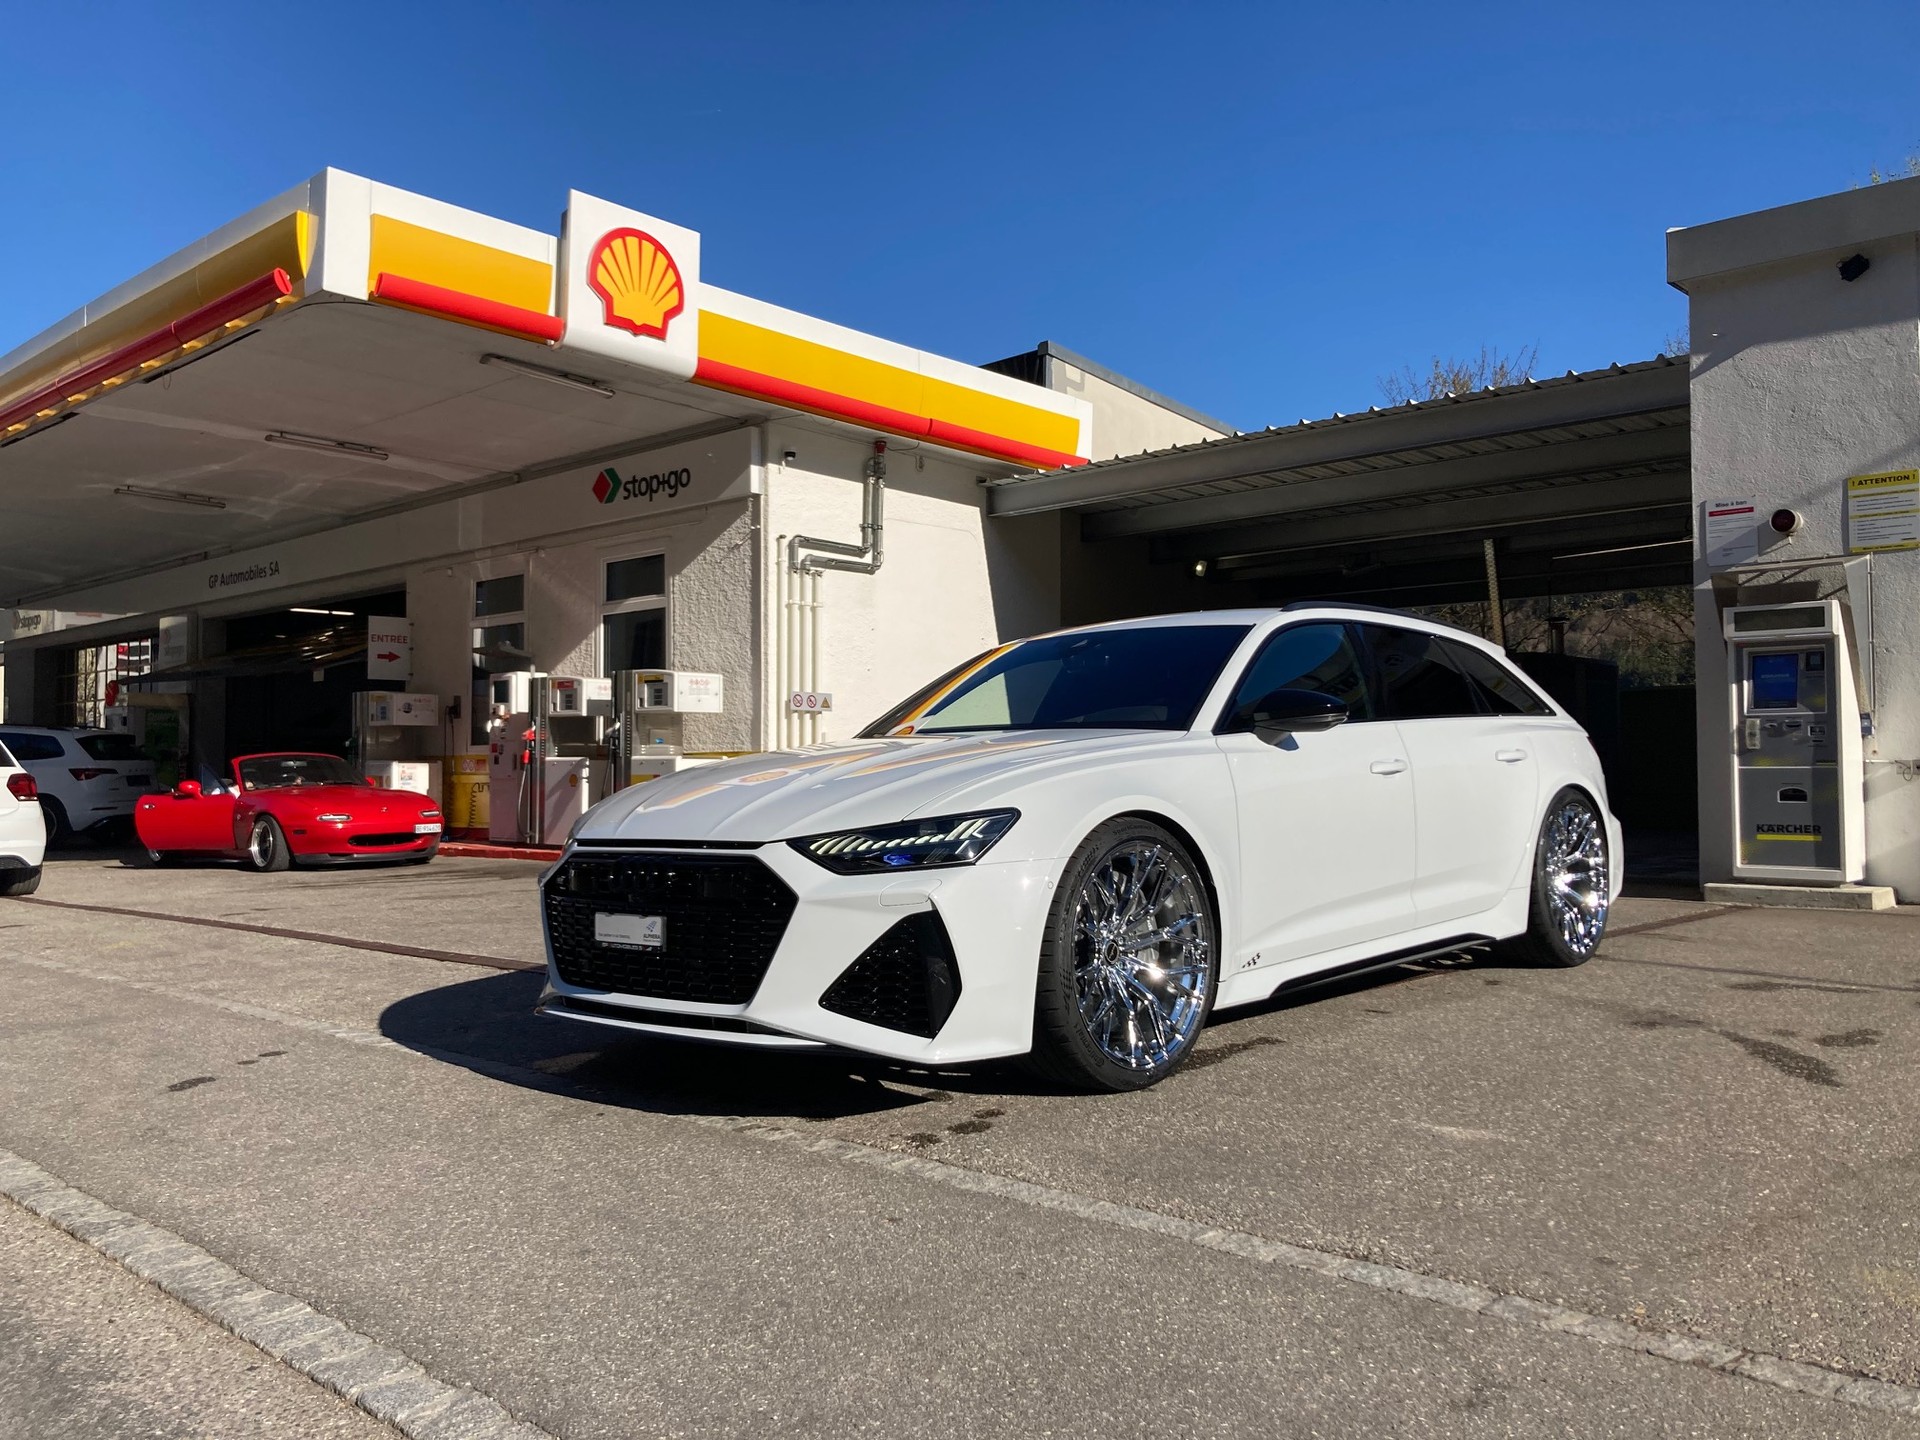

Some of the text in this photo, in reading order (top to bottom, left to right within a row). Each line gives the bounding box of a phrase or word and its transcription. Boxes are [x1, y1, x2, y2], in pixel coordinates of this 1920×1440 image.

[623, 468, 691, 502] stop+go
[1857, 474, 1910, 487] ATTENTION
[208, 561, 280, 589] GP Automobiles SA
